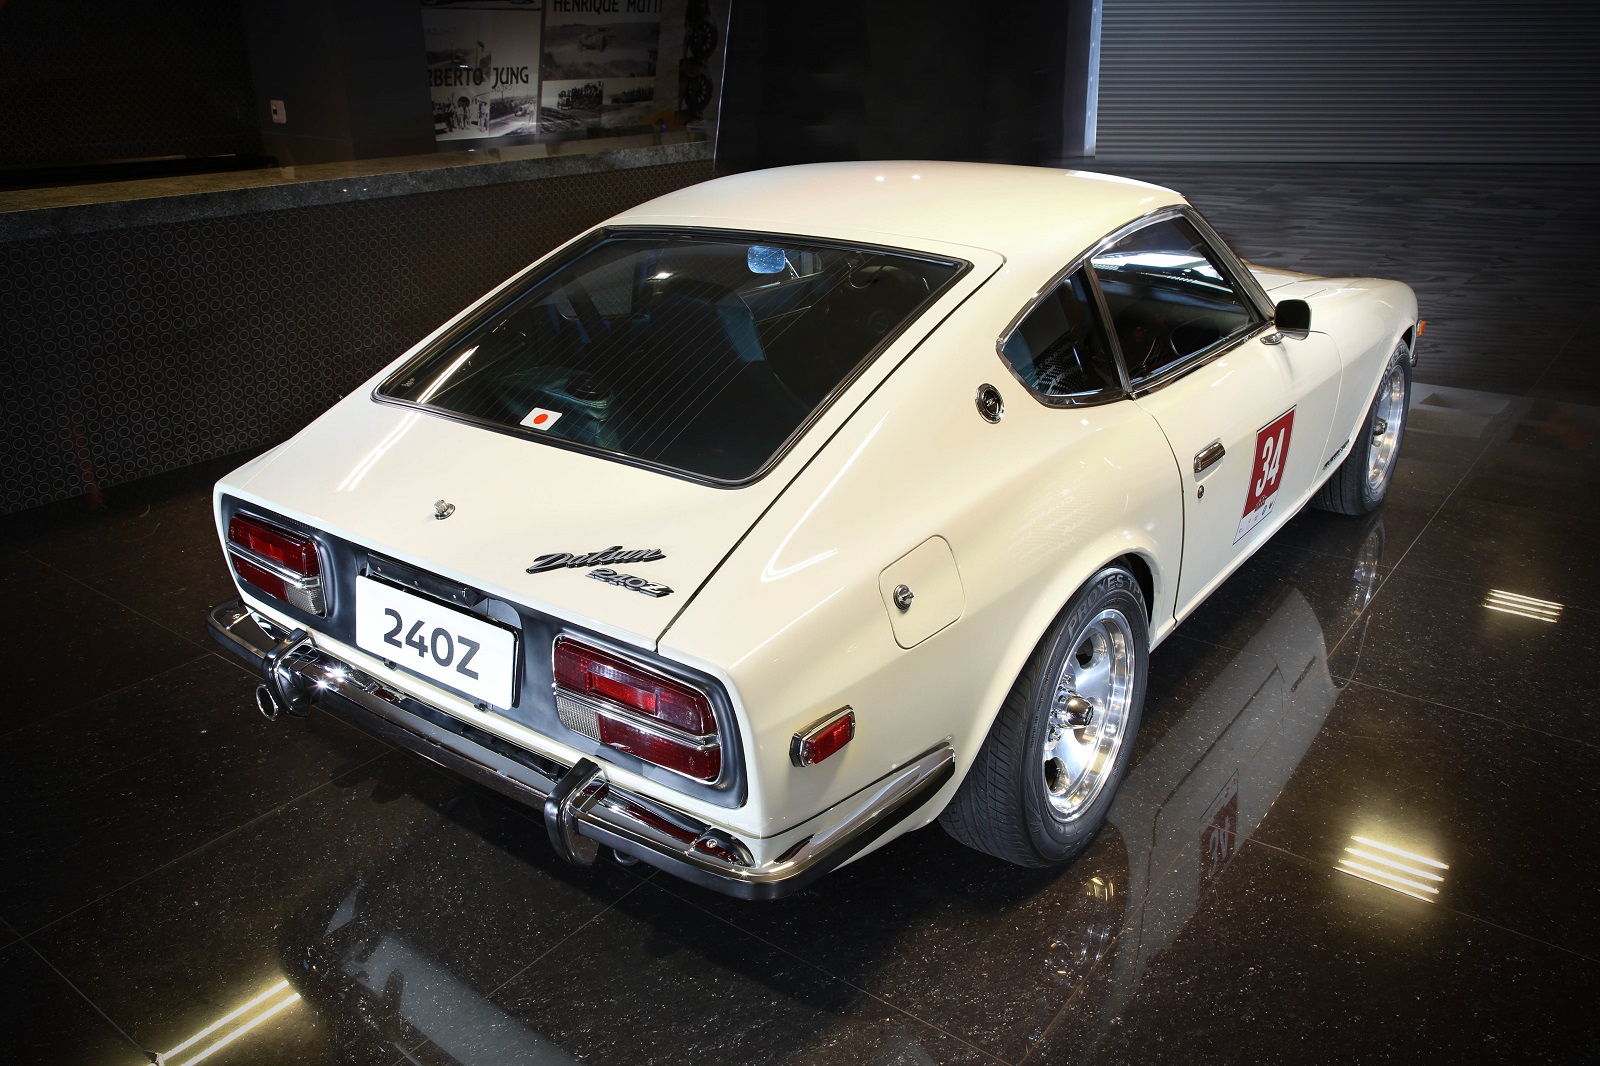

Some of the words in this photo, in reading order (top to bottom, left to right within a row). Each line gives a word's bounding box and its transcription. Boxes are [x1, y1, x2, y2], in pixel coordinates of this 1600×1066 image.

[492, 66, 529, 89] JUNG
[1255, 428, 1286, 498] 34
[1067, 574, 1125, 640] PROXES
[383, 608, 481, 681] 240Z
